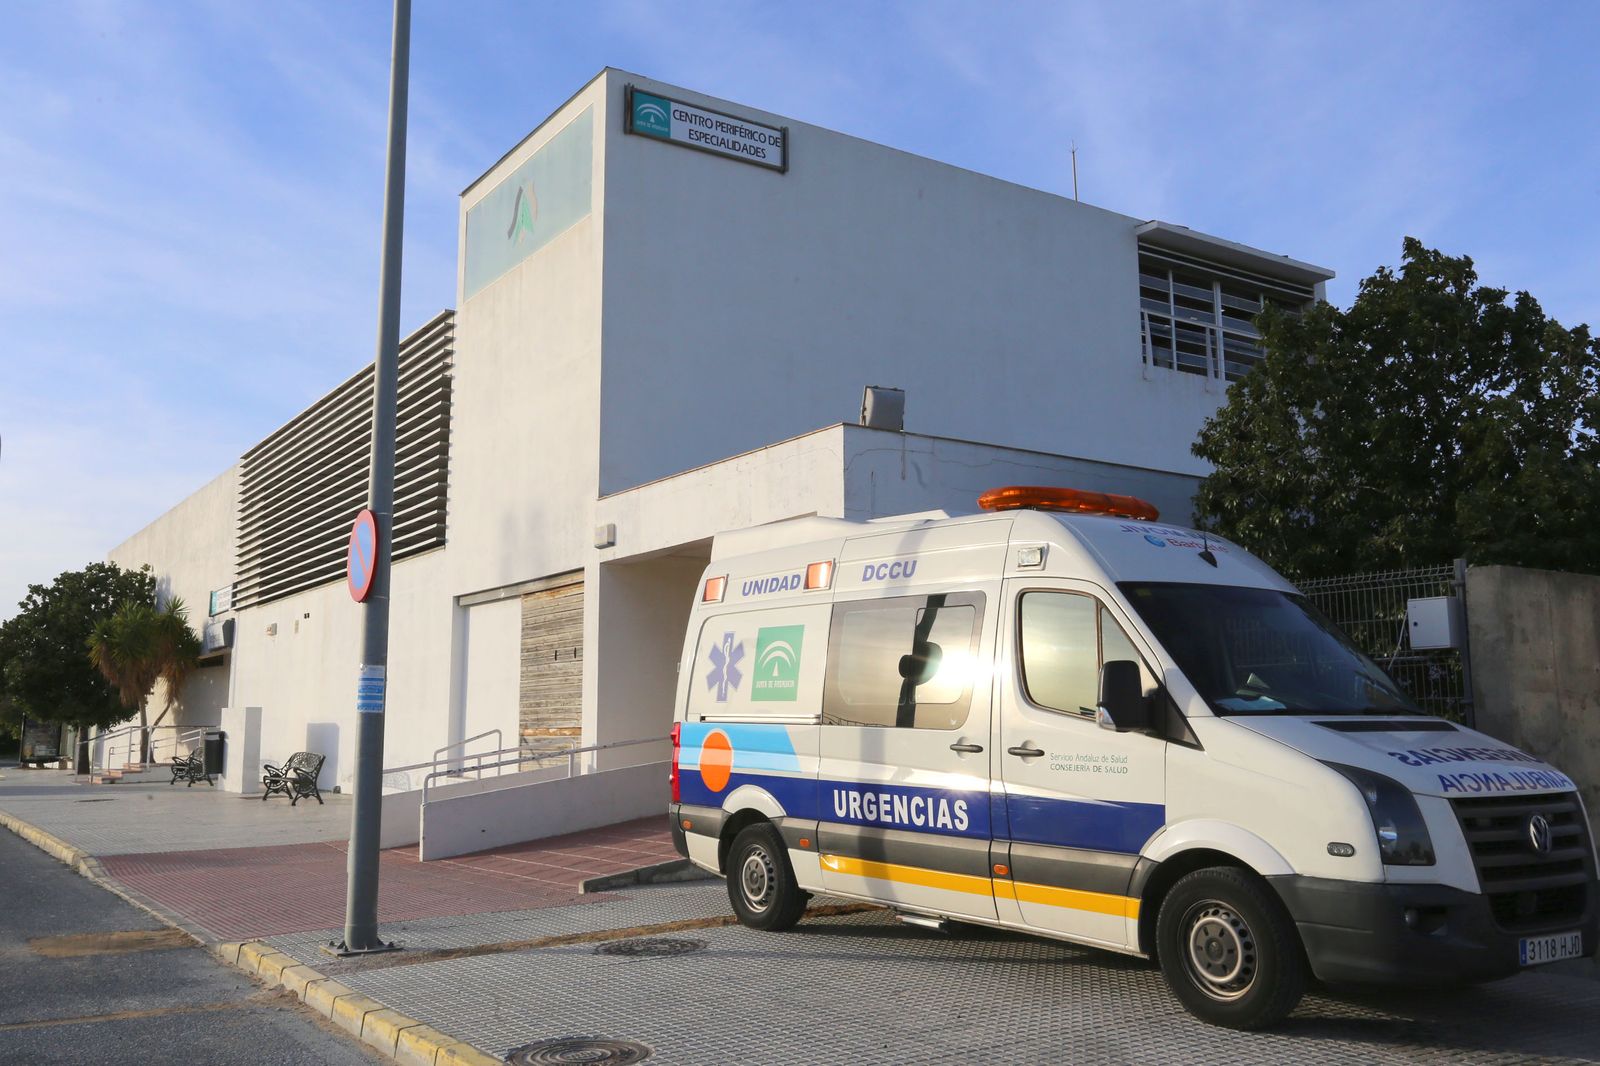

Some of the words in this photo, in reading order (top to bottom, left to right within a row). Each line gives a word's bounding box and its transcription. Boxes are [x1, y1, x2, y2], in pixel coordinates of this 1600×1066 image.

[672, 109, 713, 129] CENTRO
[715, 121, 767, 143] PERIFÉRICO
[768, 135, 781, 148] DE
[688, 128, 766, 159] ESPECIALIDADES
[741, 574, 801, 597] UNIDAD
[862, 559, 918, 582] DCCU
[1050, 752, 1074, 762] Servicio
[1076, 753, 1100, 763] Andaluz
[1101, 754, 1109, 763] de
[1111, 754, 1128, 764] Salud
[1093, 765, 1102, 773] DE
[1105, 765, 1129, 774] SALUD
[833, 789, 969, 831] URGENCIAS
[1528, 938, 1558, 961] 3118
[1560, 935, 1581, 957] HJD
